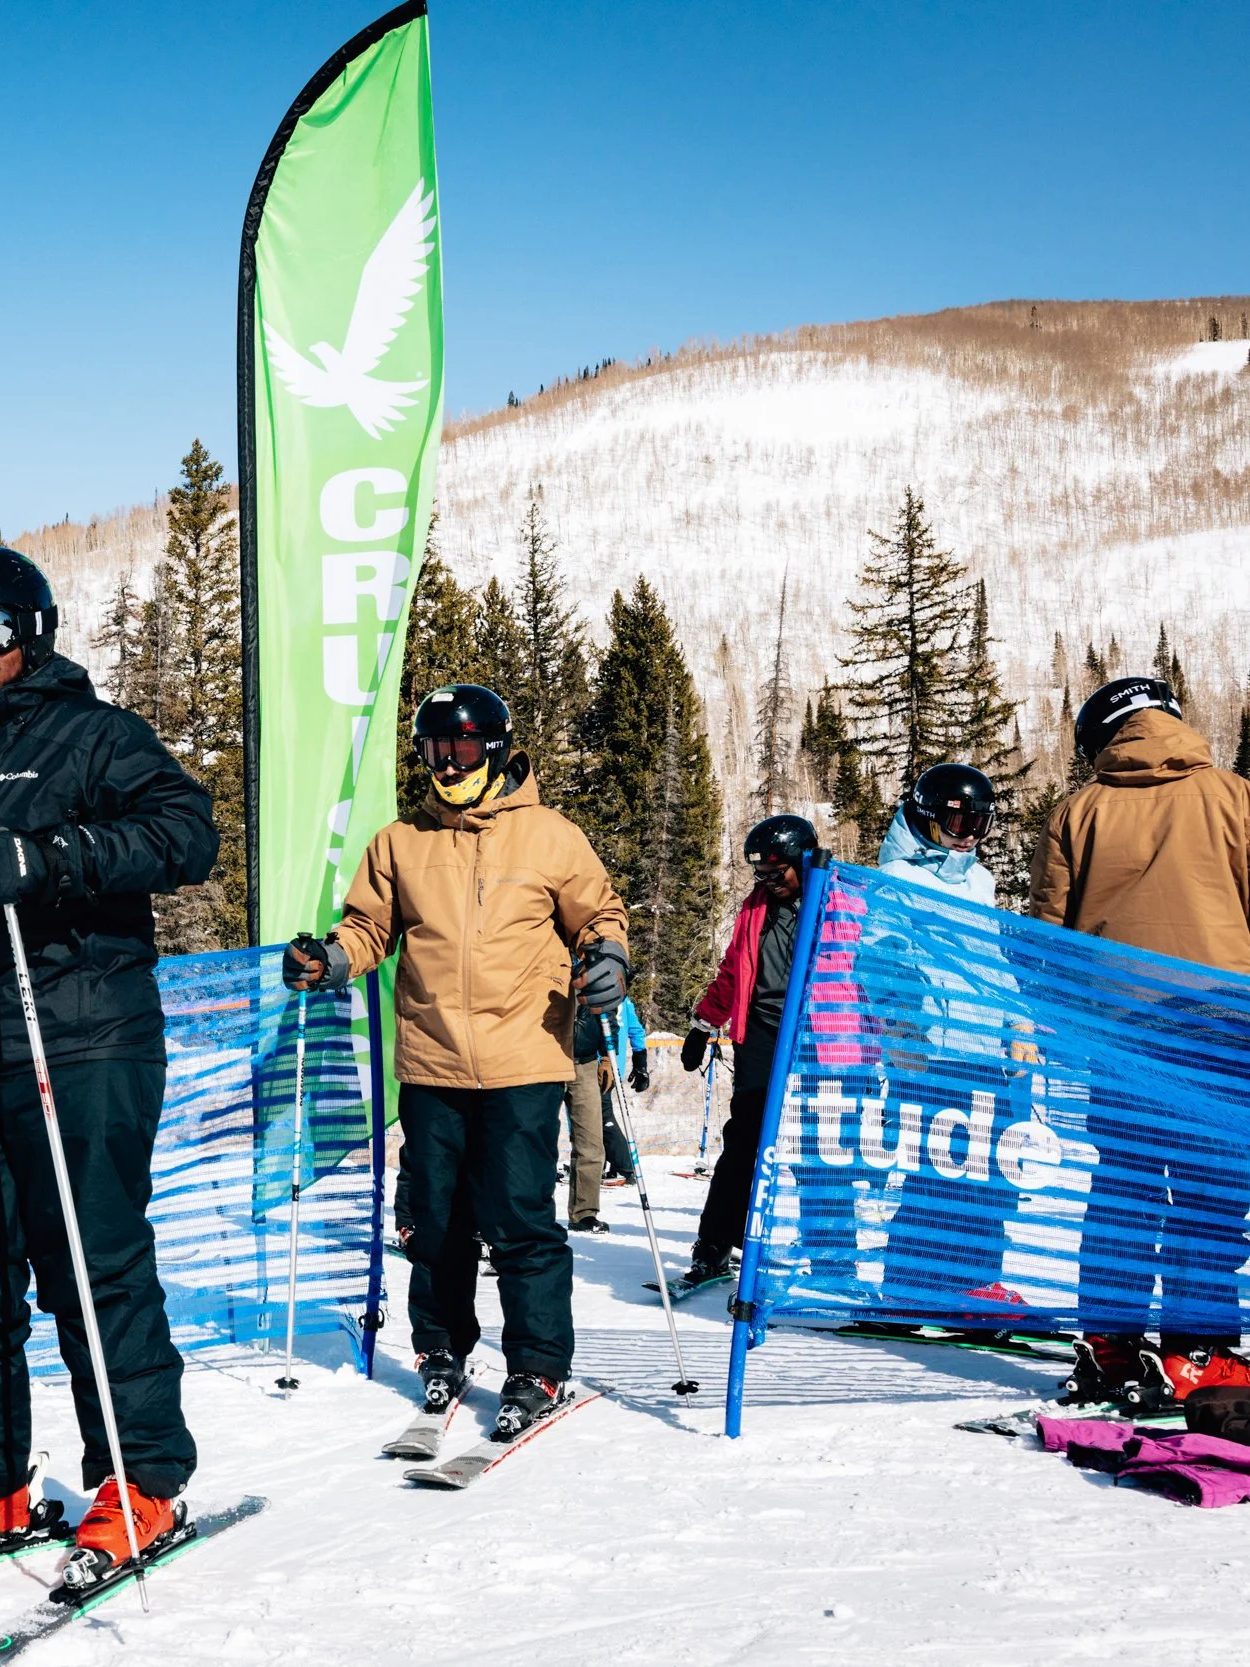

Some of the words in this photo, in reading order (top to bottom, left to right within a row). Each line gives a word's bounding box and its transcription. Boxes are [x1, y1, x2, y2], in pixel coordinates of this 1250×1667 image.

[1110, 684, 1150, 703] SMITH
[5, 770, 39, 780] Columbia
[916, 806, 936, 818] SMITH
[14, 837, 27, 877] DAKINE
[772, 1073, 1062, 1190] itude
